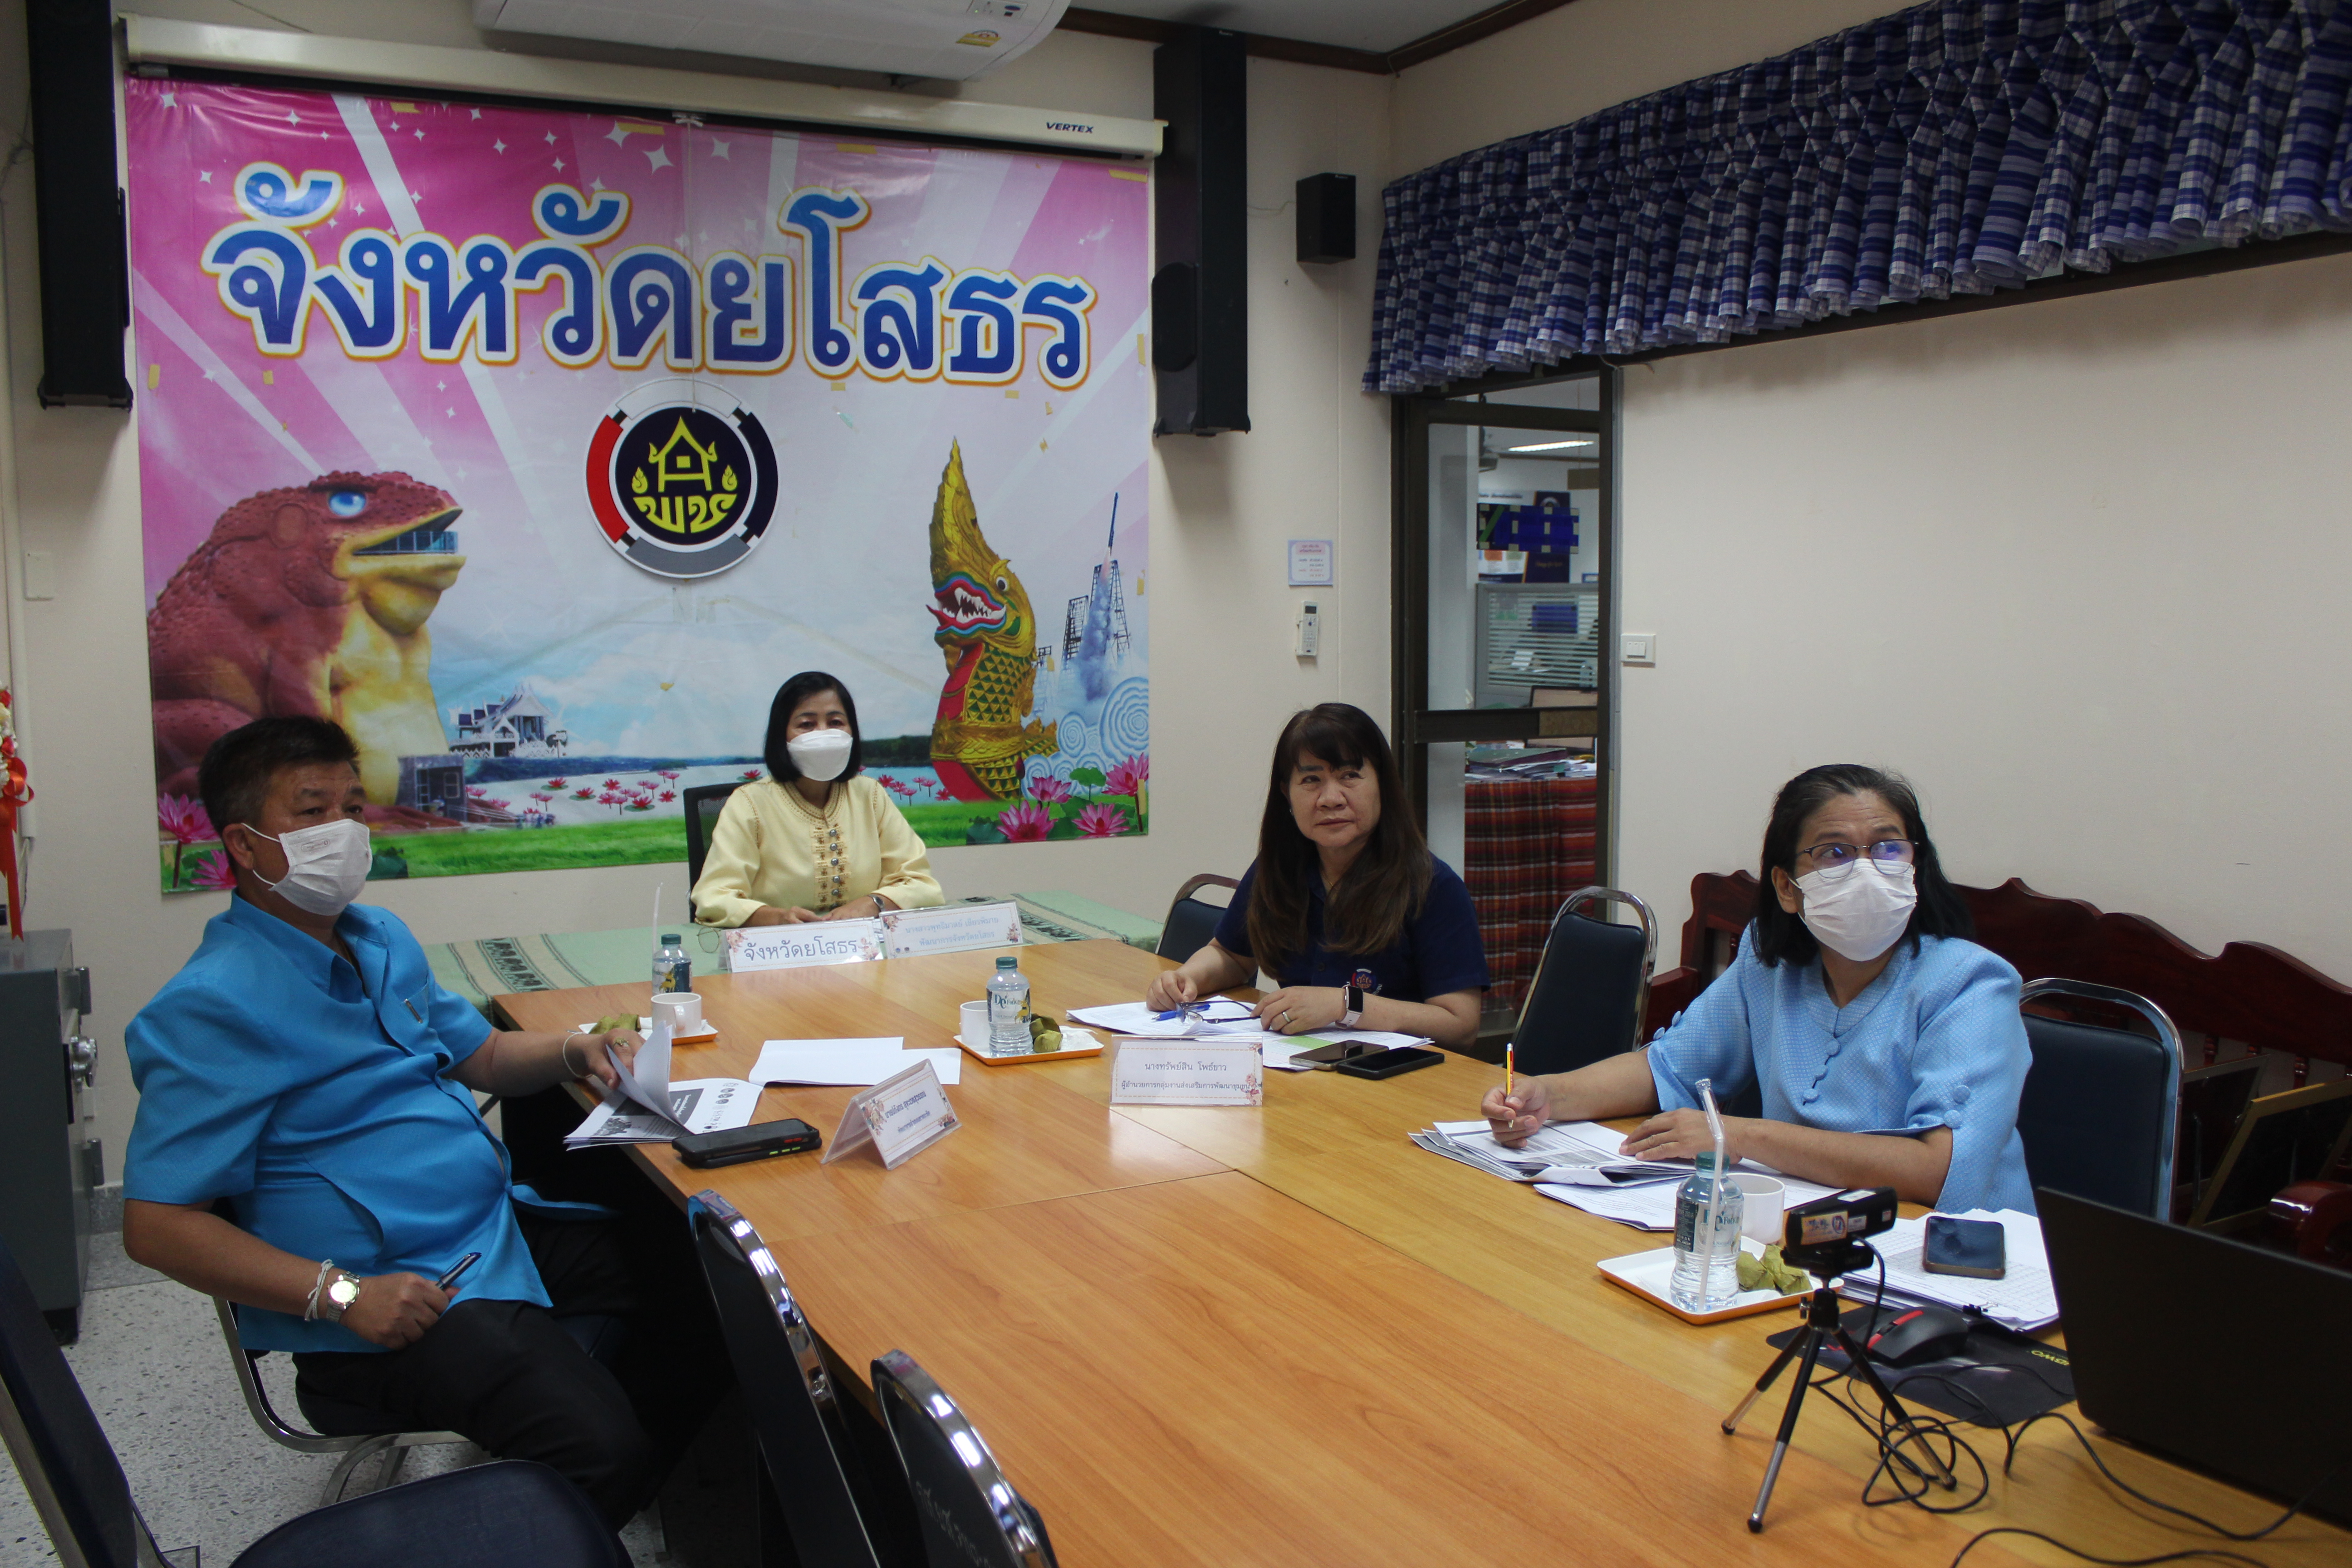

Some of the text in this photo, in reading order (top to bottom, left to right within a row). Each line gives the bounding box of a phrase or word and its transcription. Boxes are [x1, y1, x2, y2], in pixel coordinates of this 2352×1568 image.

[1046, 122, 1093, 133] VERTEX
[203, 162, 1094, 387] จังหวัดยโสธร
[744, 936, 857, 961] จังหวัดยโสธร
[1145, 1061, 1193, 1071] นางทรัพย์สิน
